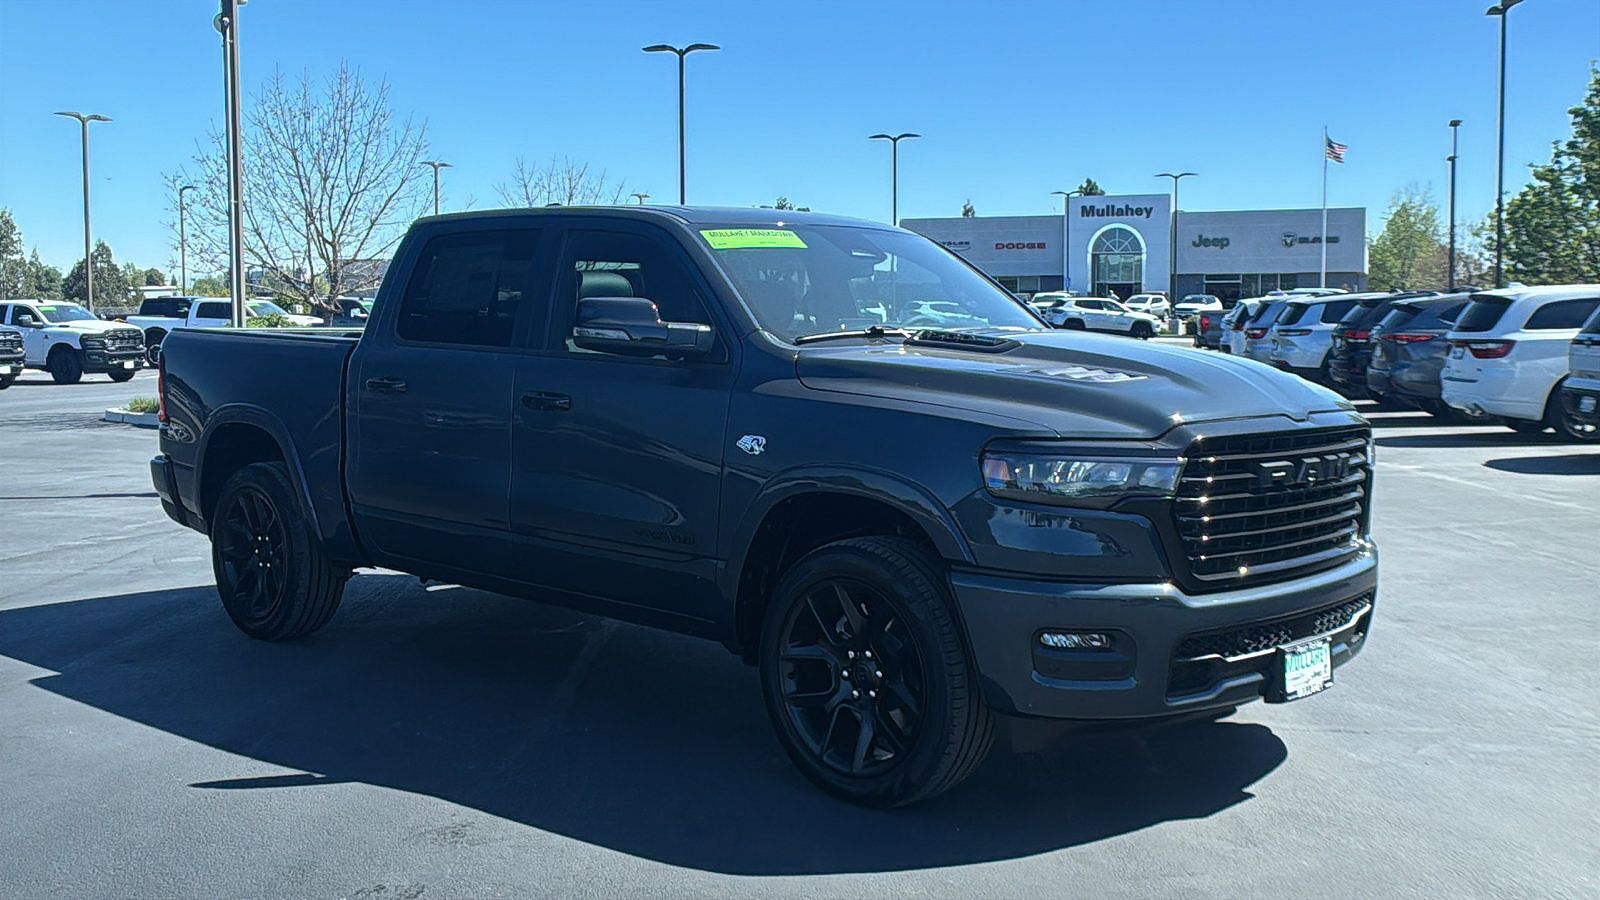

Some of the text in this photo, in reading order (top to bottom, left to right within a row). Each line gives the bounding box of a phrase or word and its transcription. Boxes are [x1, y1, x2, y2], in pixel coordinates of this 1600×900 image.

[1081, 204, 1153, 218] Mullahey
[995, 242, 1047, 250] DODGE
[1191, 234, 1230, 249] Jeep
[1259, 452, 1352, 484] RAM
